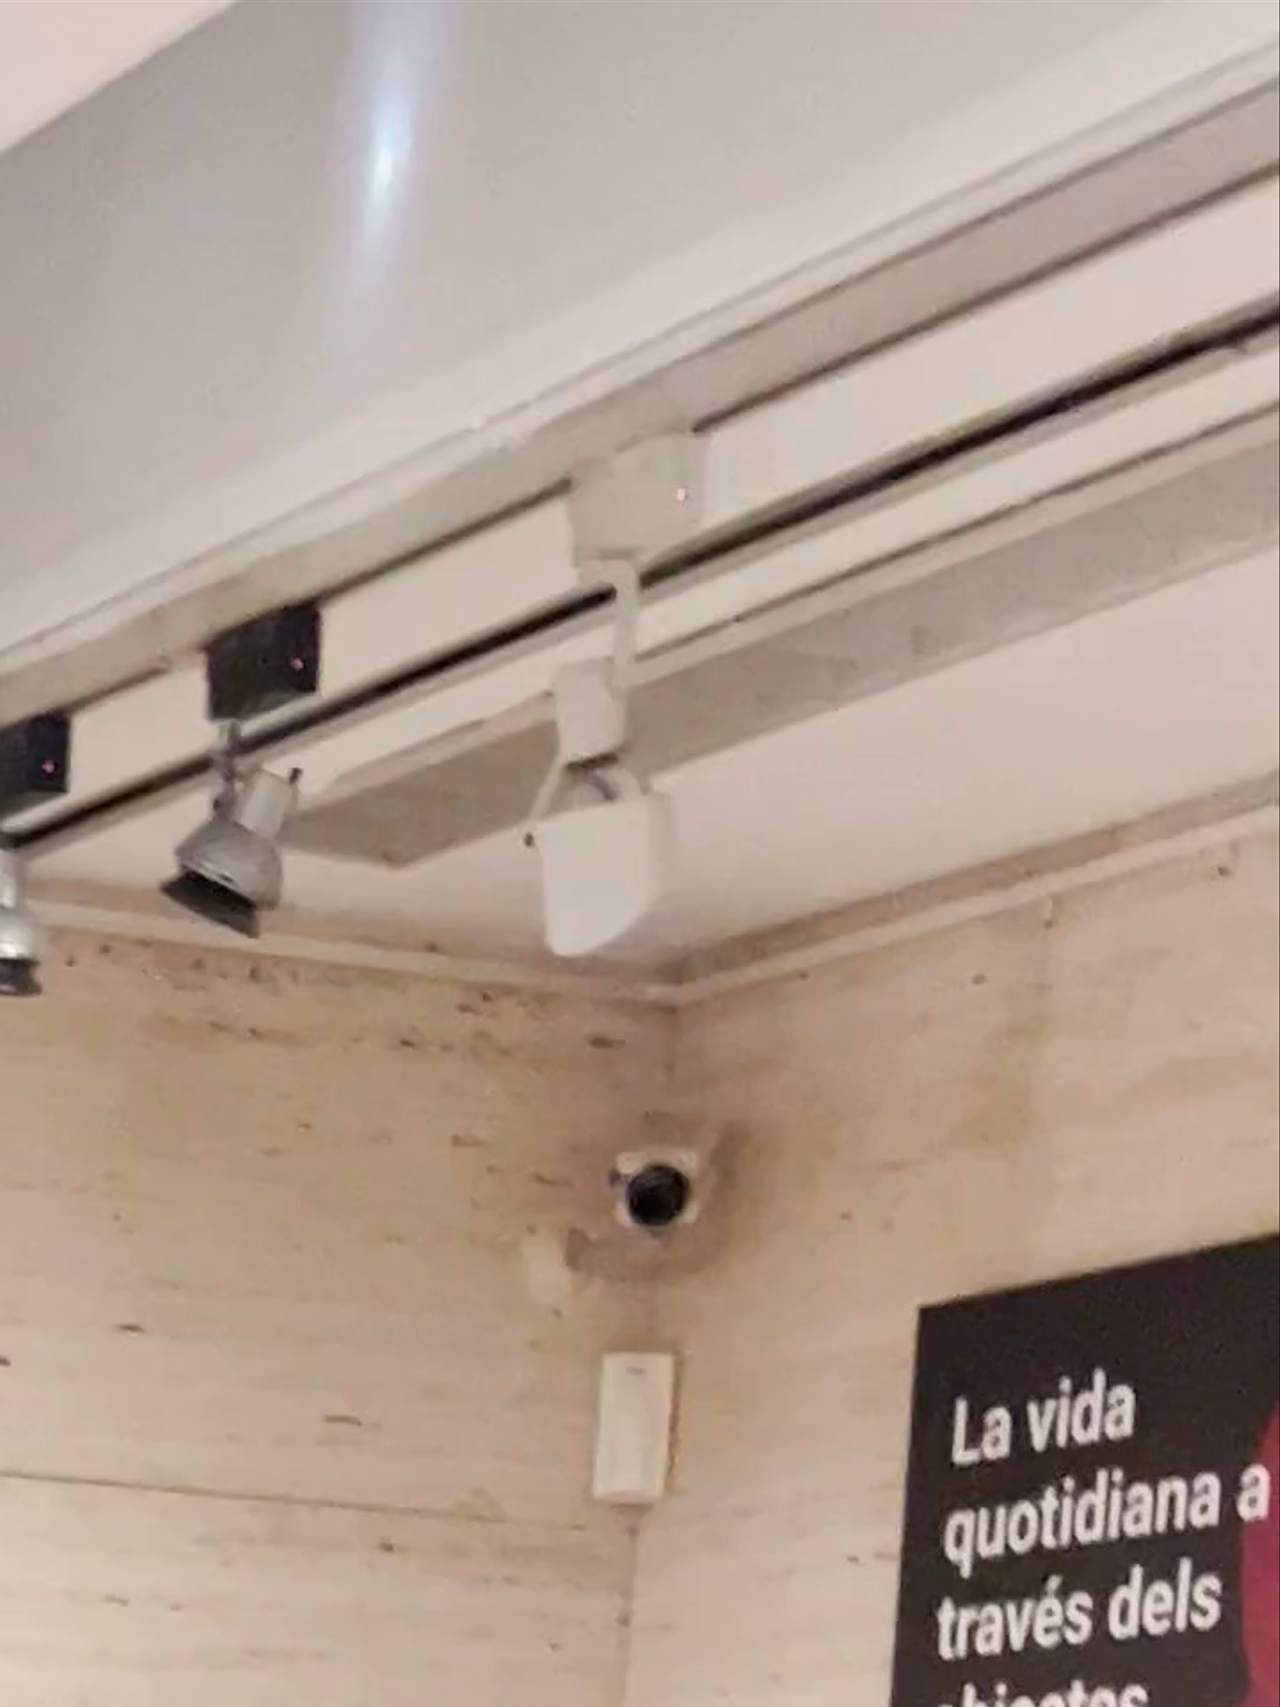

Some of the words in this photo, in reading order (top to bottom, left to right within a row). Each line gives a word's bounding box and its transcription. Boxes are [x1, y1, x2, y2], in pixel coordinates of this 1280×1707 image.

[950, 1395, 1012, 1468] La
[1026, 1367, 1137, 1454] vida
[942, 1465, 1221, 1580] quotidiana
[1236, 1463, 1273, 1522] a
[935, 1573, 1095, 1662] través
[1107, 1555, 1224, 1642] dels
